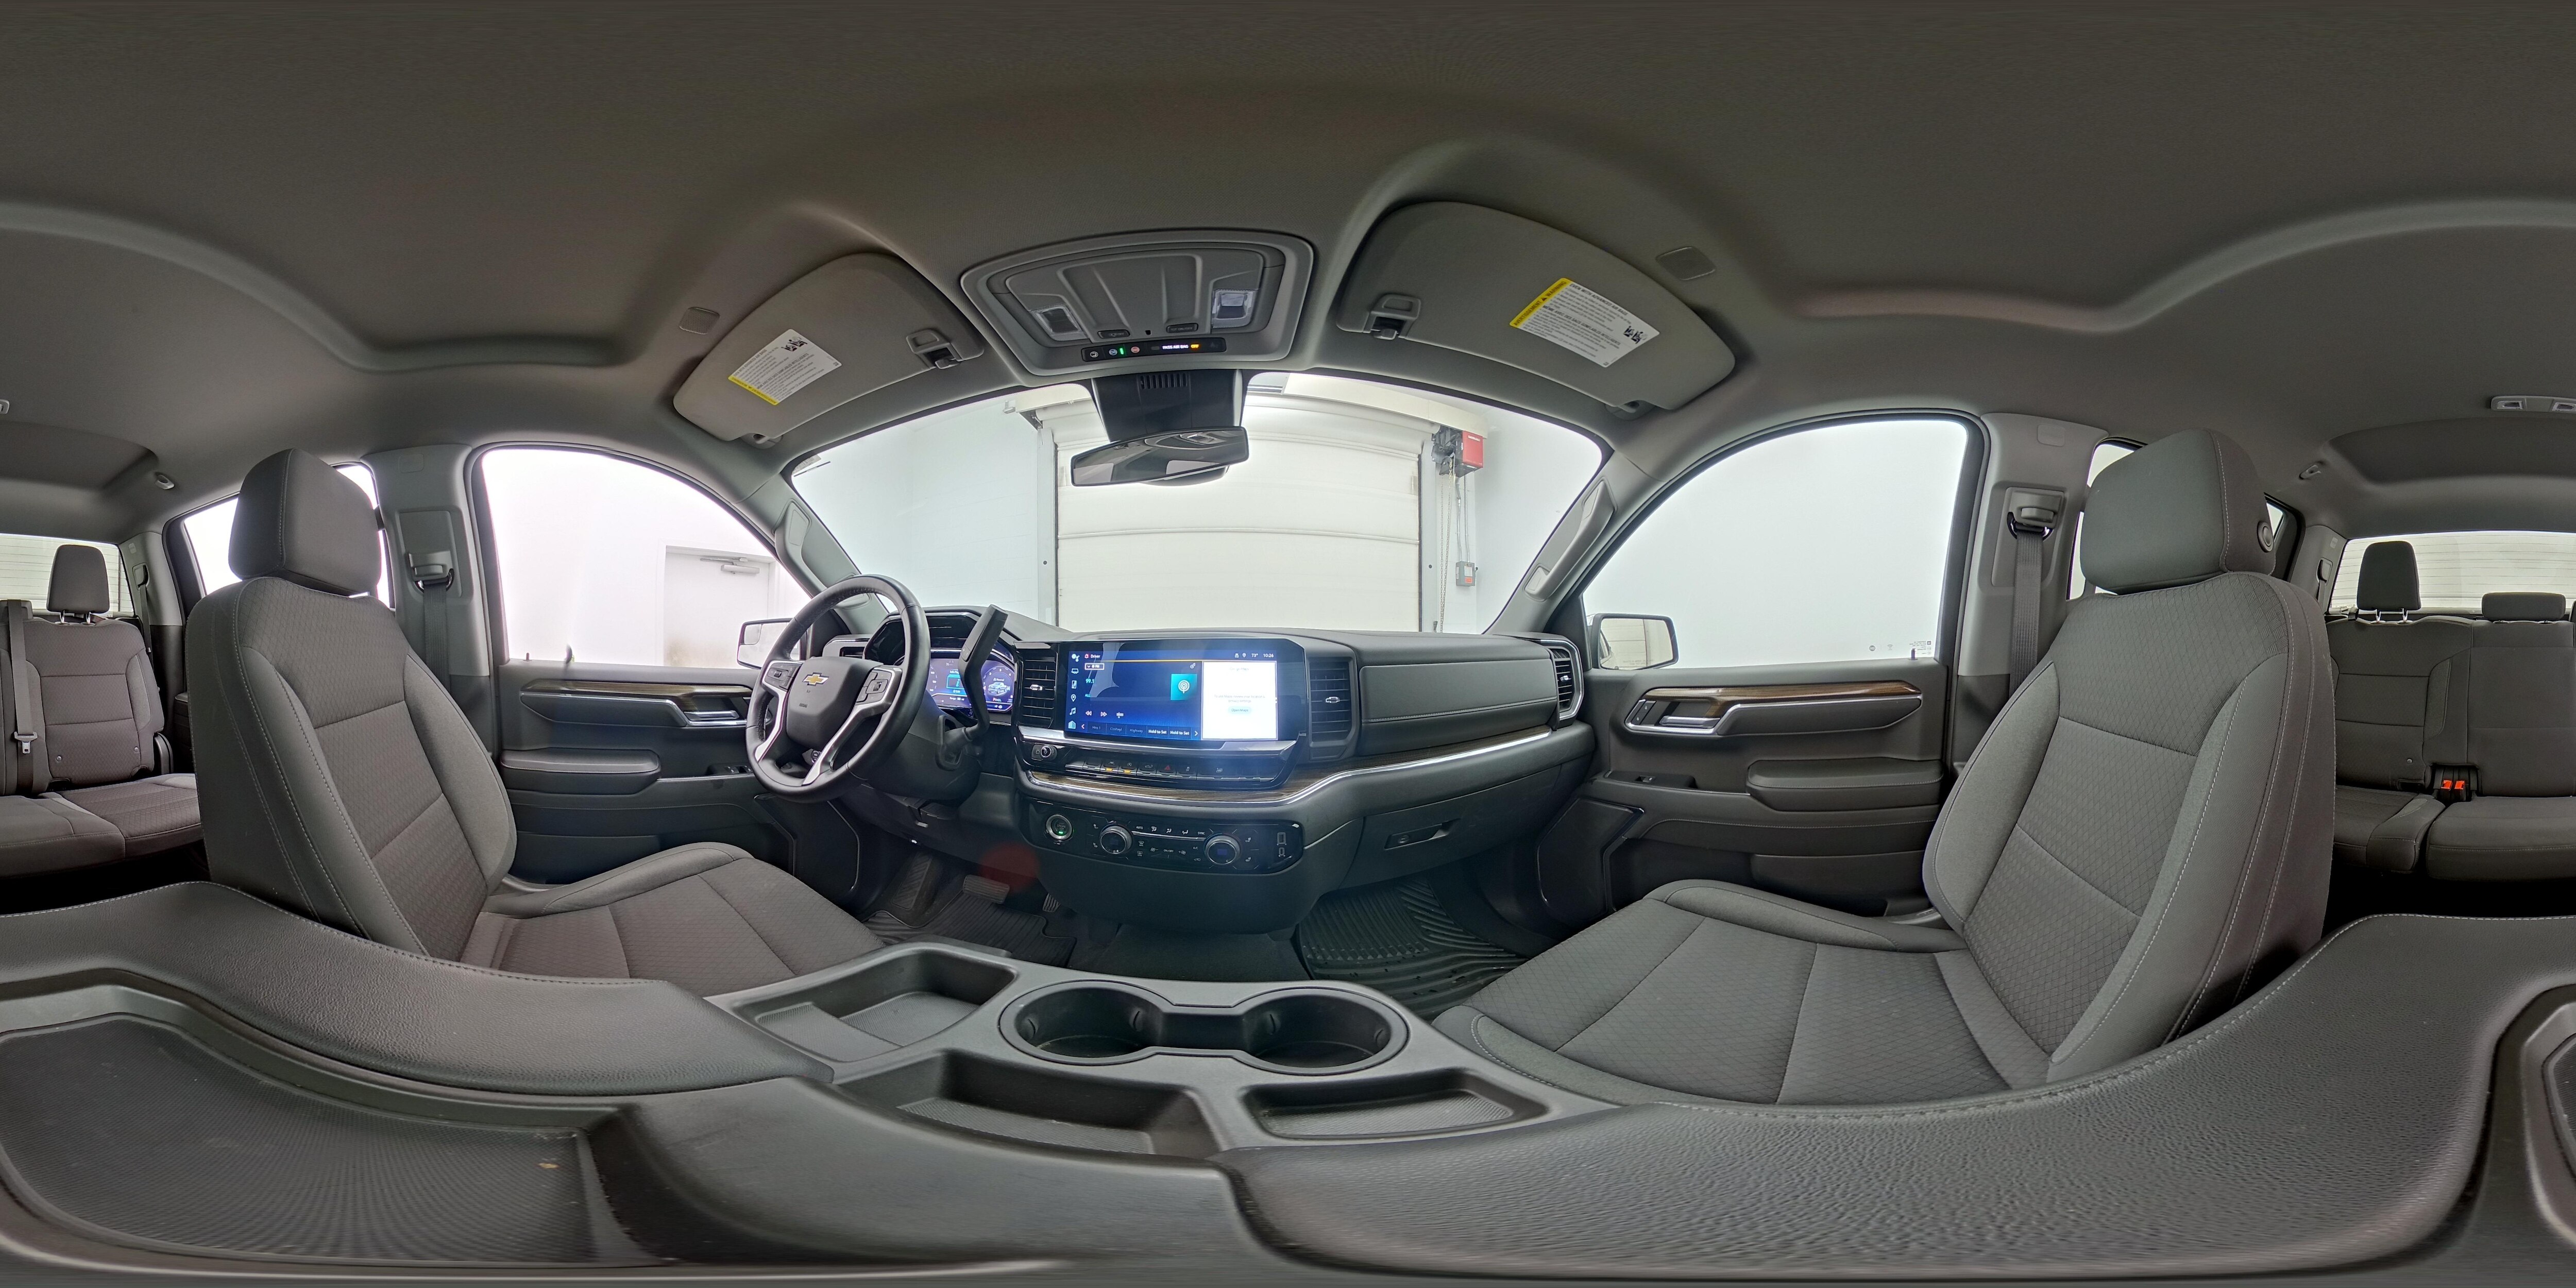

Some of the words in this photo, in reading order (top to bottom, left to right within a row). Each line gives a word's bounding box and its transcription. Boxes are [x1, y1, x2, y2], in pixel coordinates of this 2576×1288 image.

[1546, 281, 1566, 297] WARNING
[1592, 294, 1612, 306] ADVANCED
[1514, 300, 1541, 326] AVERTISSEMENT
